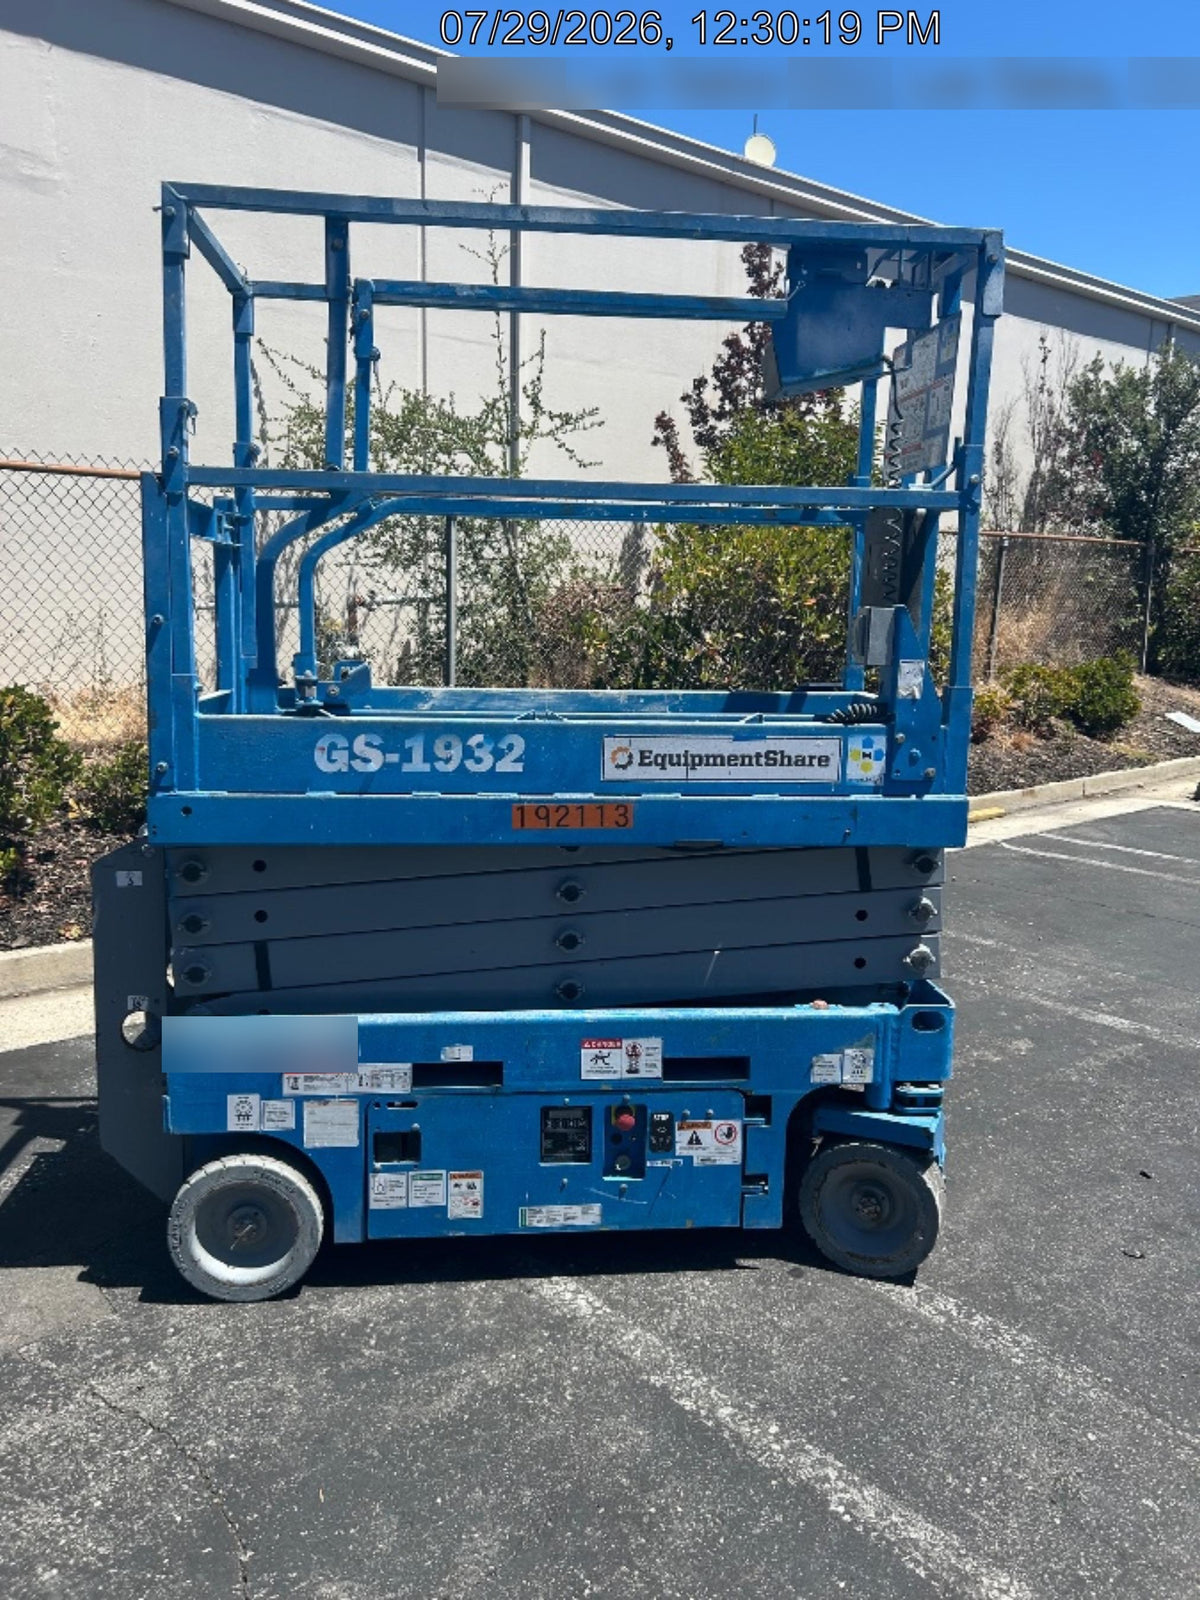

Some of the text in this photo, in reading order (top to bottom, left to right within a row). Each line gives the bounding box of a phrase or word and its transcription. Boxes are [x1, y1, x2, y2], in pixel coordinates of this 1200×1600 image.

[314, 733, 526, 773] GS-1932
[638, 749, 830, 770] EquipmentShare
[516, 804, 629, 828] 192113
